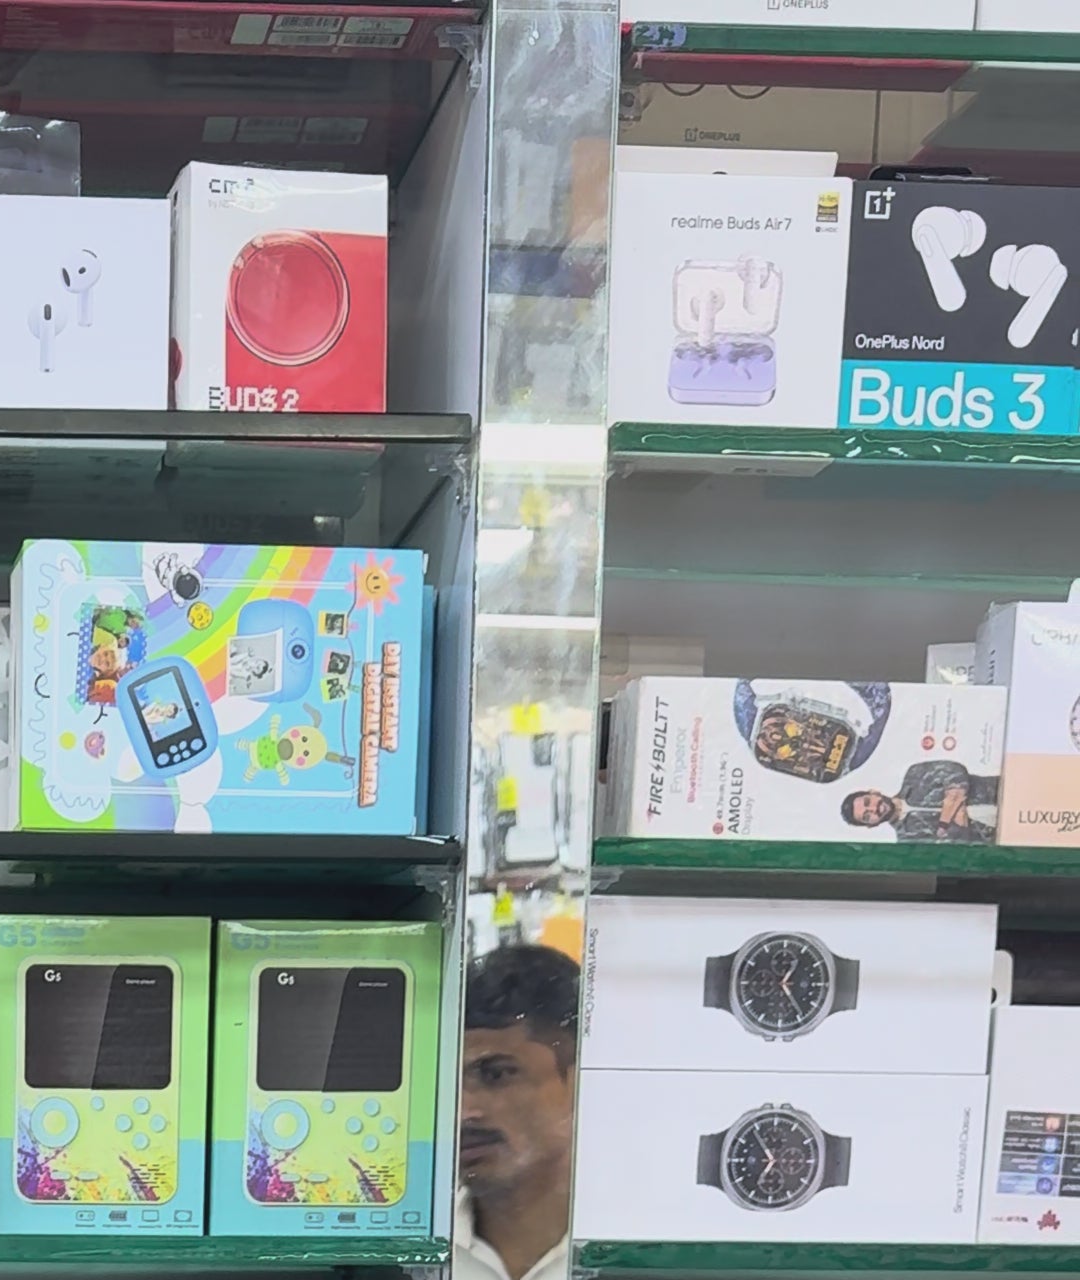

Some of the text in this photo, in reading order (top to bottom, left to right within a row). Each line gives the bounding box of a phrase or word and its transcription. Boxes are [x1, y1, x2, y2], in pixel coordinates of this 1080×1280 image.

[671, 216, 723, 229] realme
[727, 216, 761, 230] Buds
[855, 334, 945, 351] OnePlus Nord
[209, 386, 299, 412] BUDS 2
[849, 368, 1046, 429] Buds 3
[381, 643, 402, 753] DIY INSTANT
[359, 663, 382, 808] DIGITAL CAMERA
[728, 767, 744, 834] AMOLED
[587, 928, 599, 959] Smart
[953, 1183, 965, 1214] Smart
